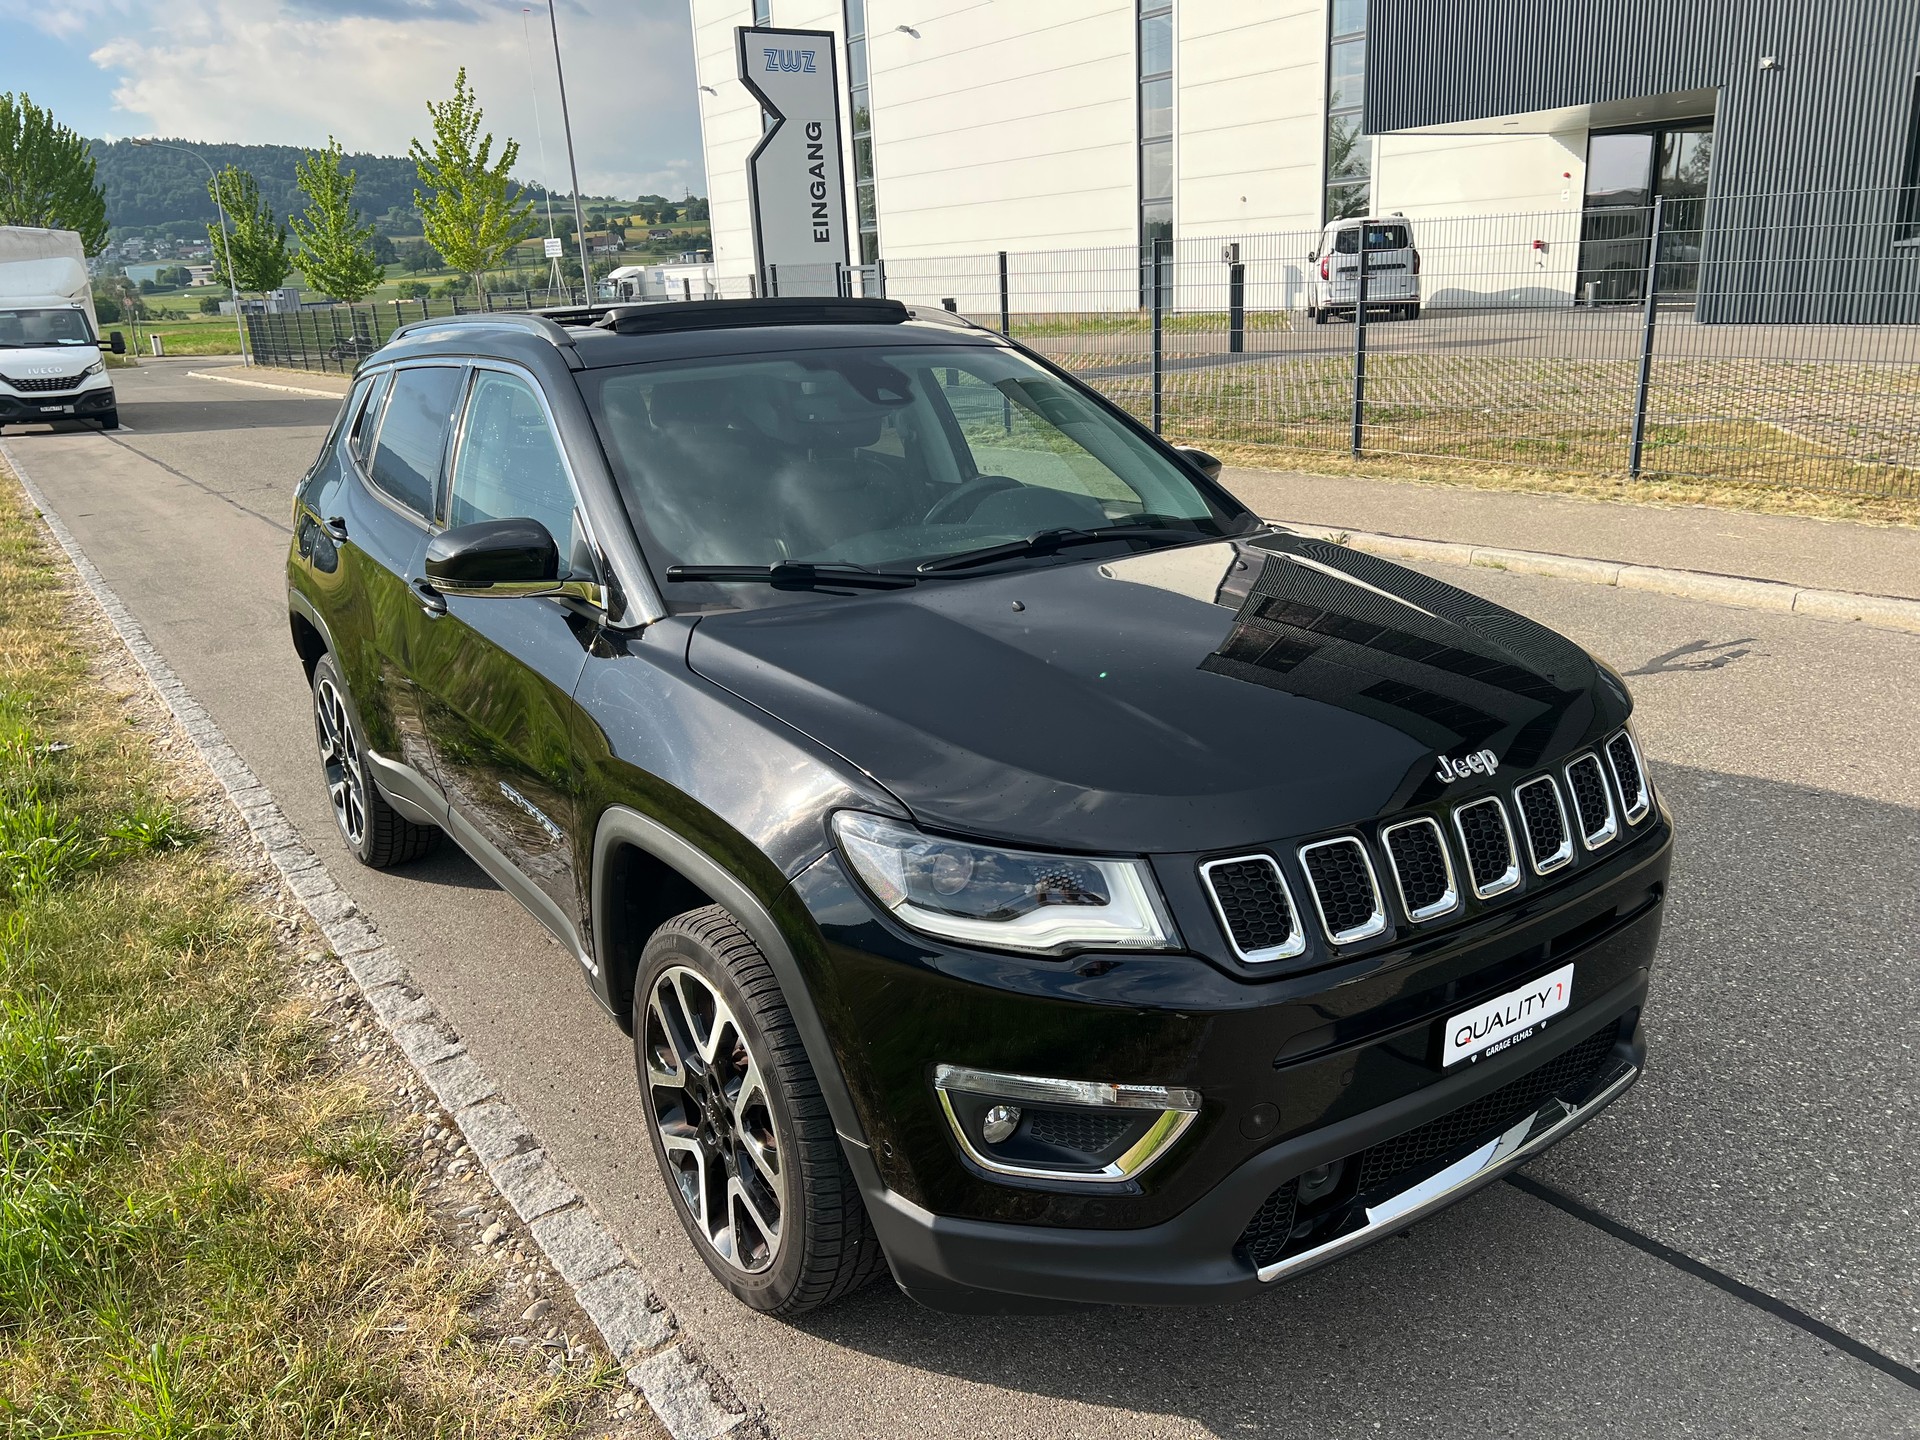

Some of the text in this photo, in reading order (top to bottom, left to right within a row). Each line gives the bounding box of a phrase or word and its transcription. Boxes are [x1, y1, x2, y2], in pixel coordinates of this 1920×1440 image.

[805, 121, 830, 243] EINGANG
[27, 366, 62, 375] IVECO
[1435, 748, 1499, 784] Jeep
[1454, 982, 1563, 1048] QUALITY 1
[1485, 1027, 1533, 1057] GARAGE ELMAS
